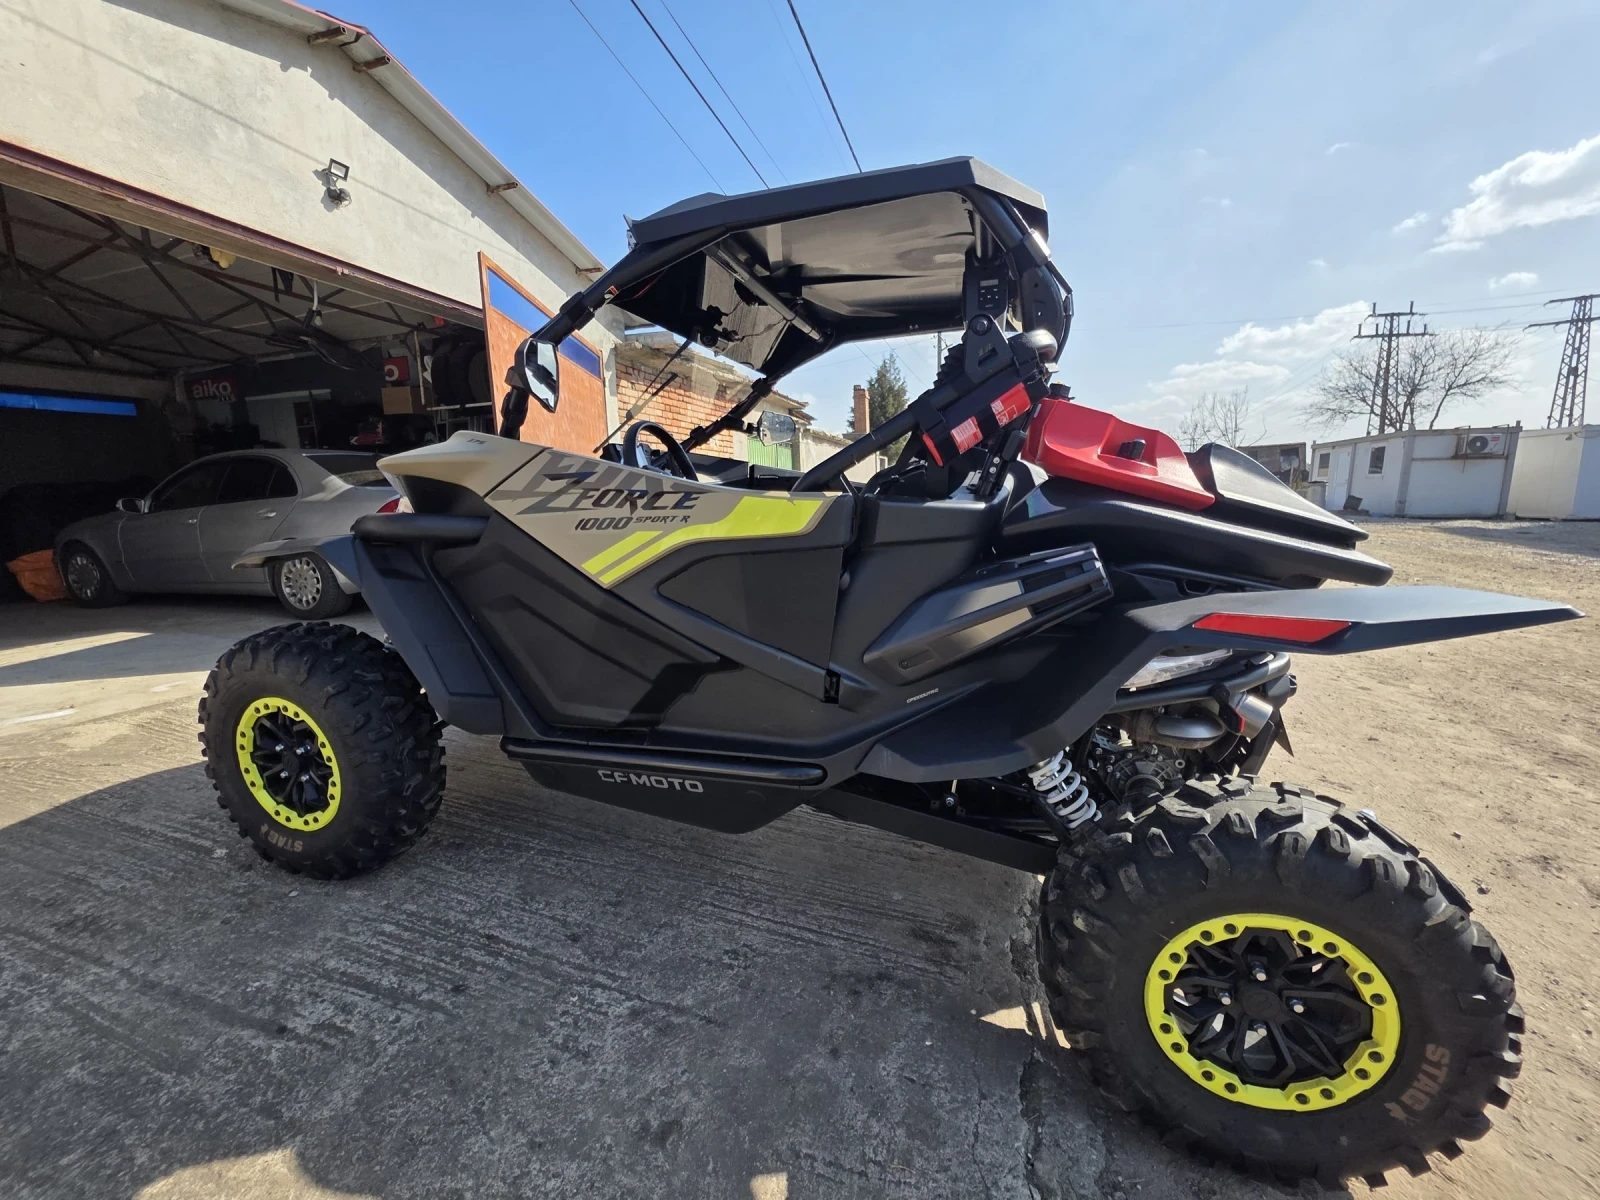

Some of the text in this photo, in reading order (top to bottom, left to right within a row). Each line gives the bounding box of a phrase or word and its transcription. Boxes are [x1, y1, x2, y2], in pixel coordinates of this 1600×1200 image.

[192, 379, 232, 399] aiko
[575, 515, 691, 531] 1000 SPORT R
[597, 769, 704, 793] CFMOTO
